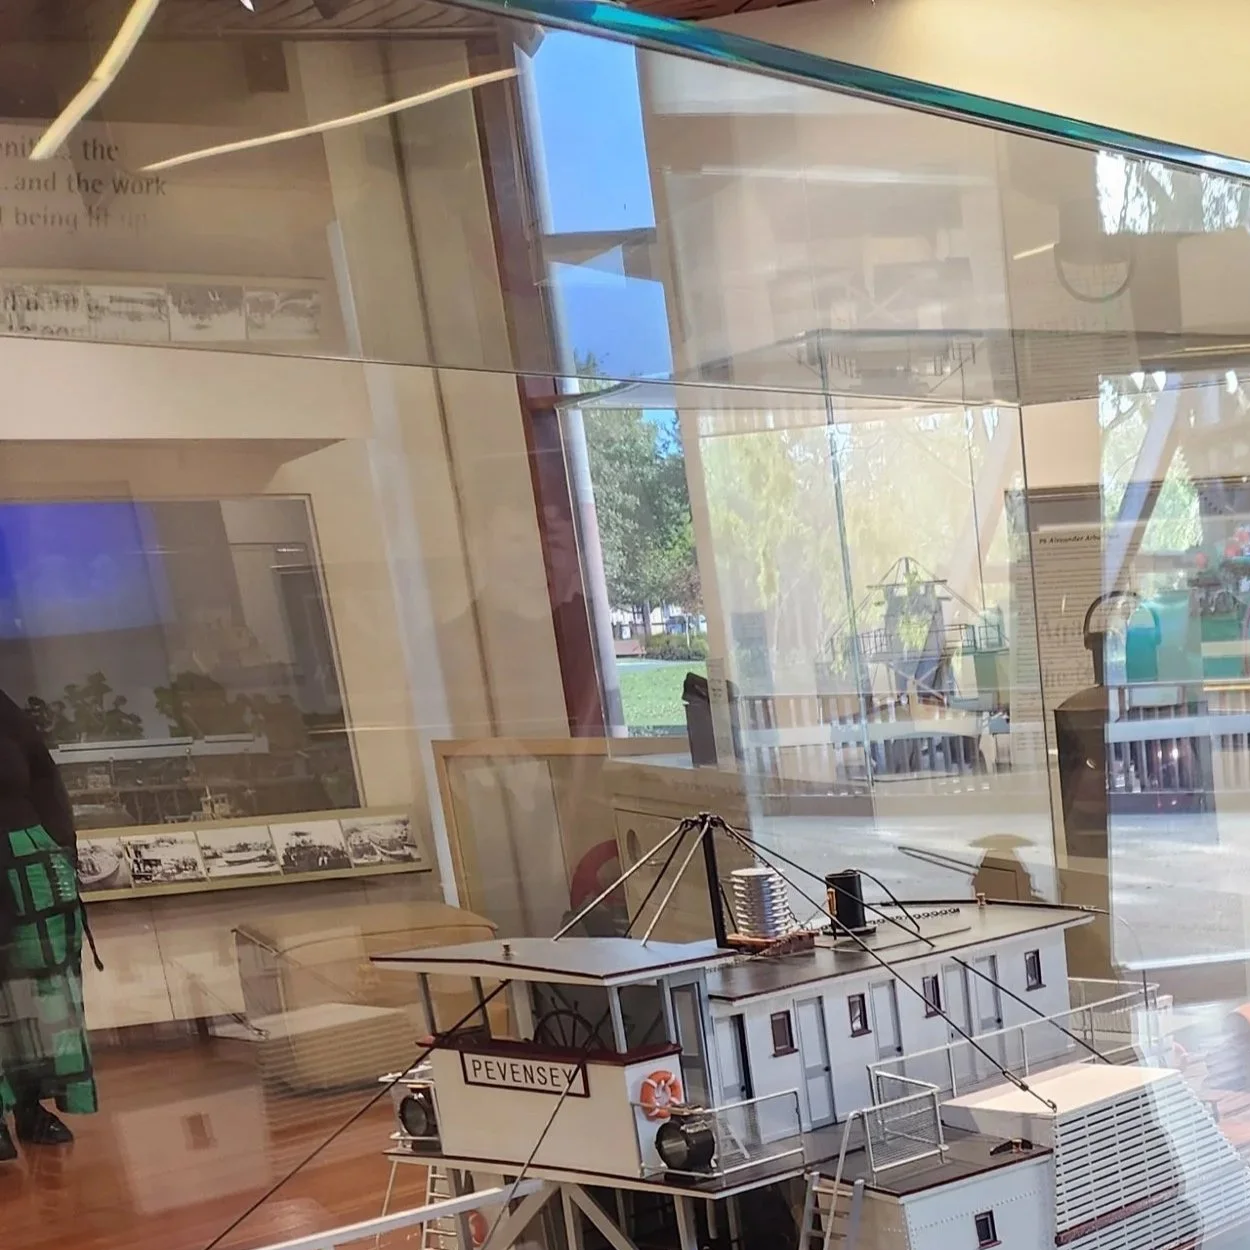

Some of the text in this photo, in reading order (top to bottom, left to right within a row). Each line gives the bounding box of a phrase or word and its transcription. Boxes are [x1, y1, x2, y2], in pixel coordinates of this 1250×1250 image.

[67, 172, 104, 194] the
[112, 176, 167, 197] work
[471, 1059, 574, 1088] PEVENSEY
